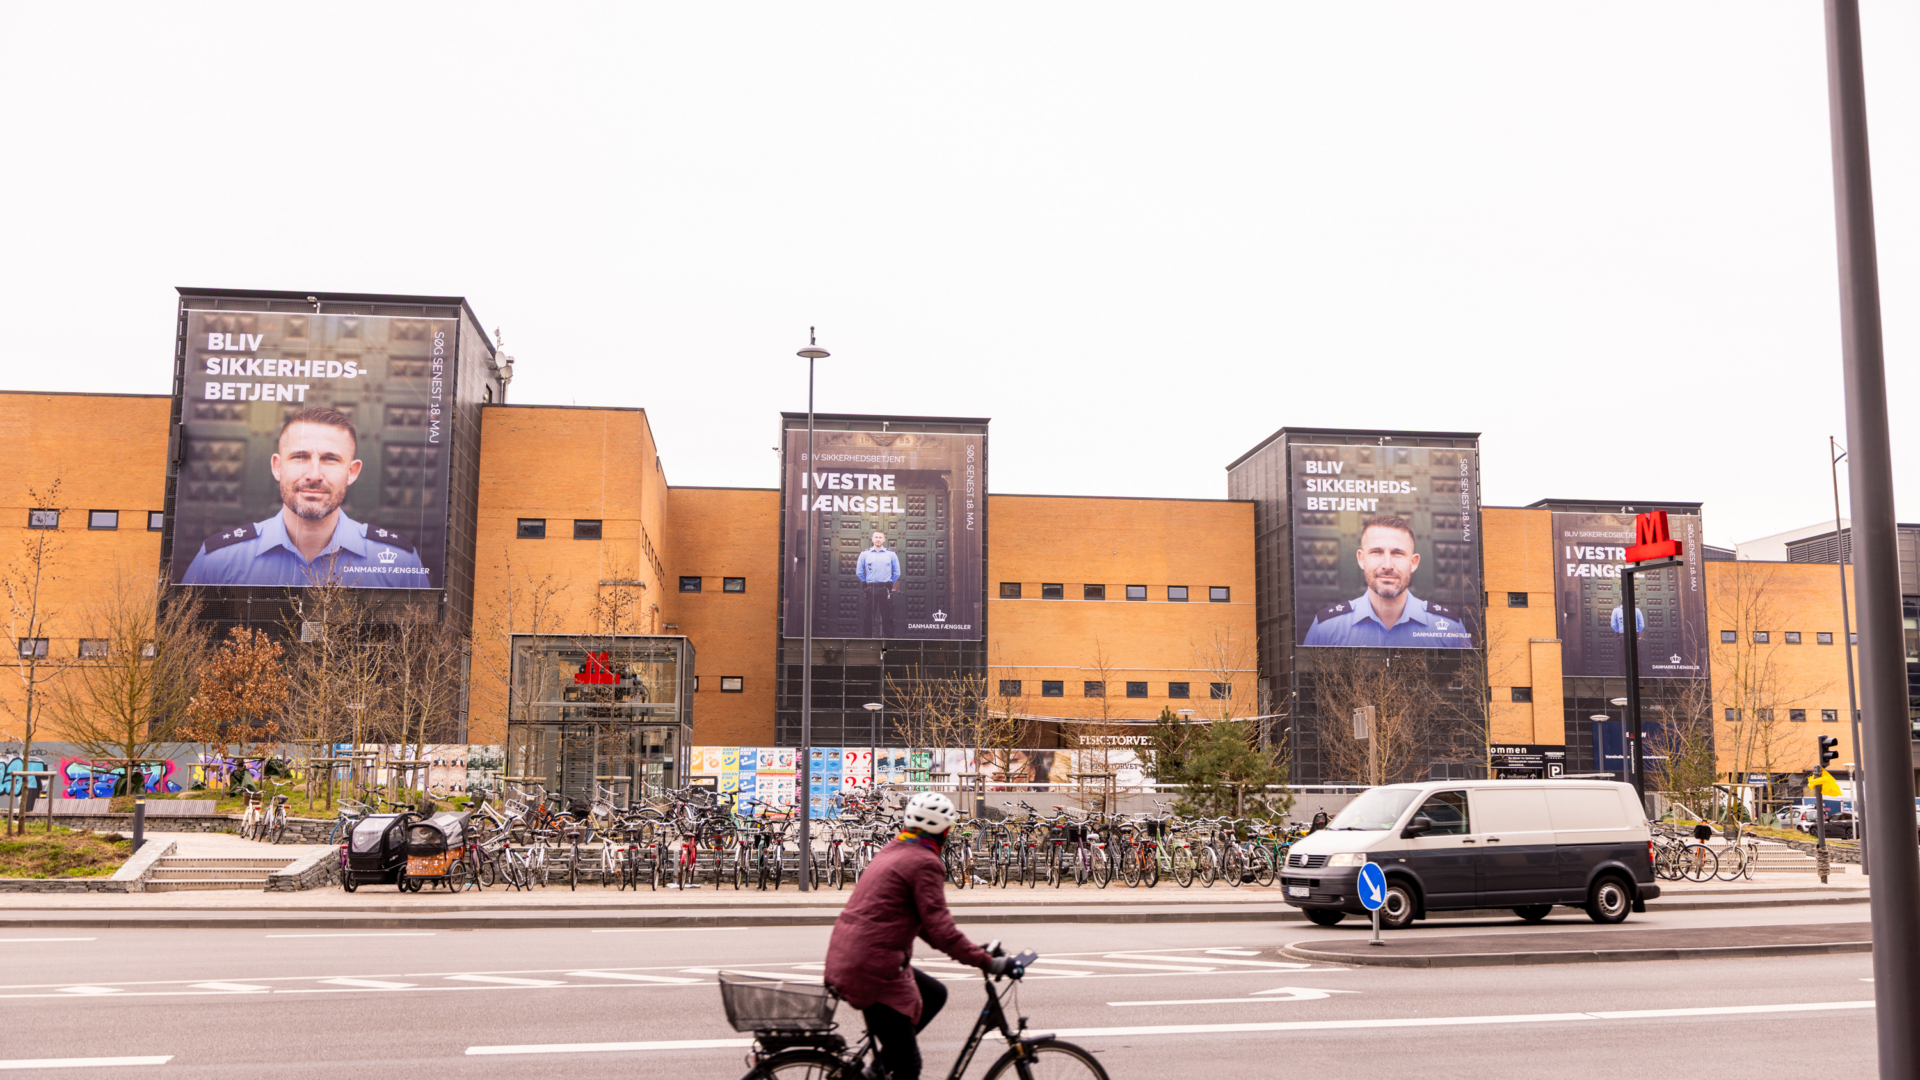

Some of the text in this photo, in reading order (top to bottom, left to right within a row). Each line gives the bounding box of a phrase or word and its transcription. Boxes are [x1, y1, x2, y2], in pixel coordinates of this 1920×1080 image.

[208, 333, 263, 352] BLIV
[206, 357, 367, 379] SIKKERHEDS-
[204, 382, 310, 402] BETJENT
[429, 331, 444, 443] SØG SENEST 18. MAJ
[801, 453, 906, 463] BIV SIKKERHEDSBETJENT
[1306, 461, 1344, 474] BLIV
[1460, 458, 1468, 476] SØG
[802, 473, 895, 491] I VESTRE
[1306, 479, 1417, 494] SIKKERHEDS-
[1461, 478, 1469, 510] SENEST
[1307, 497, 1379, 511] BETJENT
[966, 512, 974, 530] MAJ
[1463, 524, 1471, 541] MAJ
[1566, 546, 1626, 560] I VESTR
[388, 566, 430, 575] FÆNGSLER
[1551, 766, 1560, 777] P
